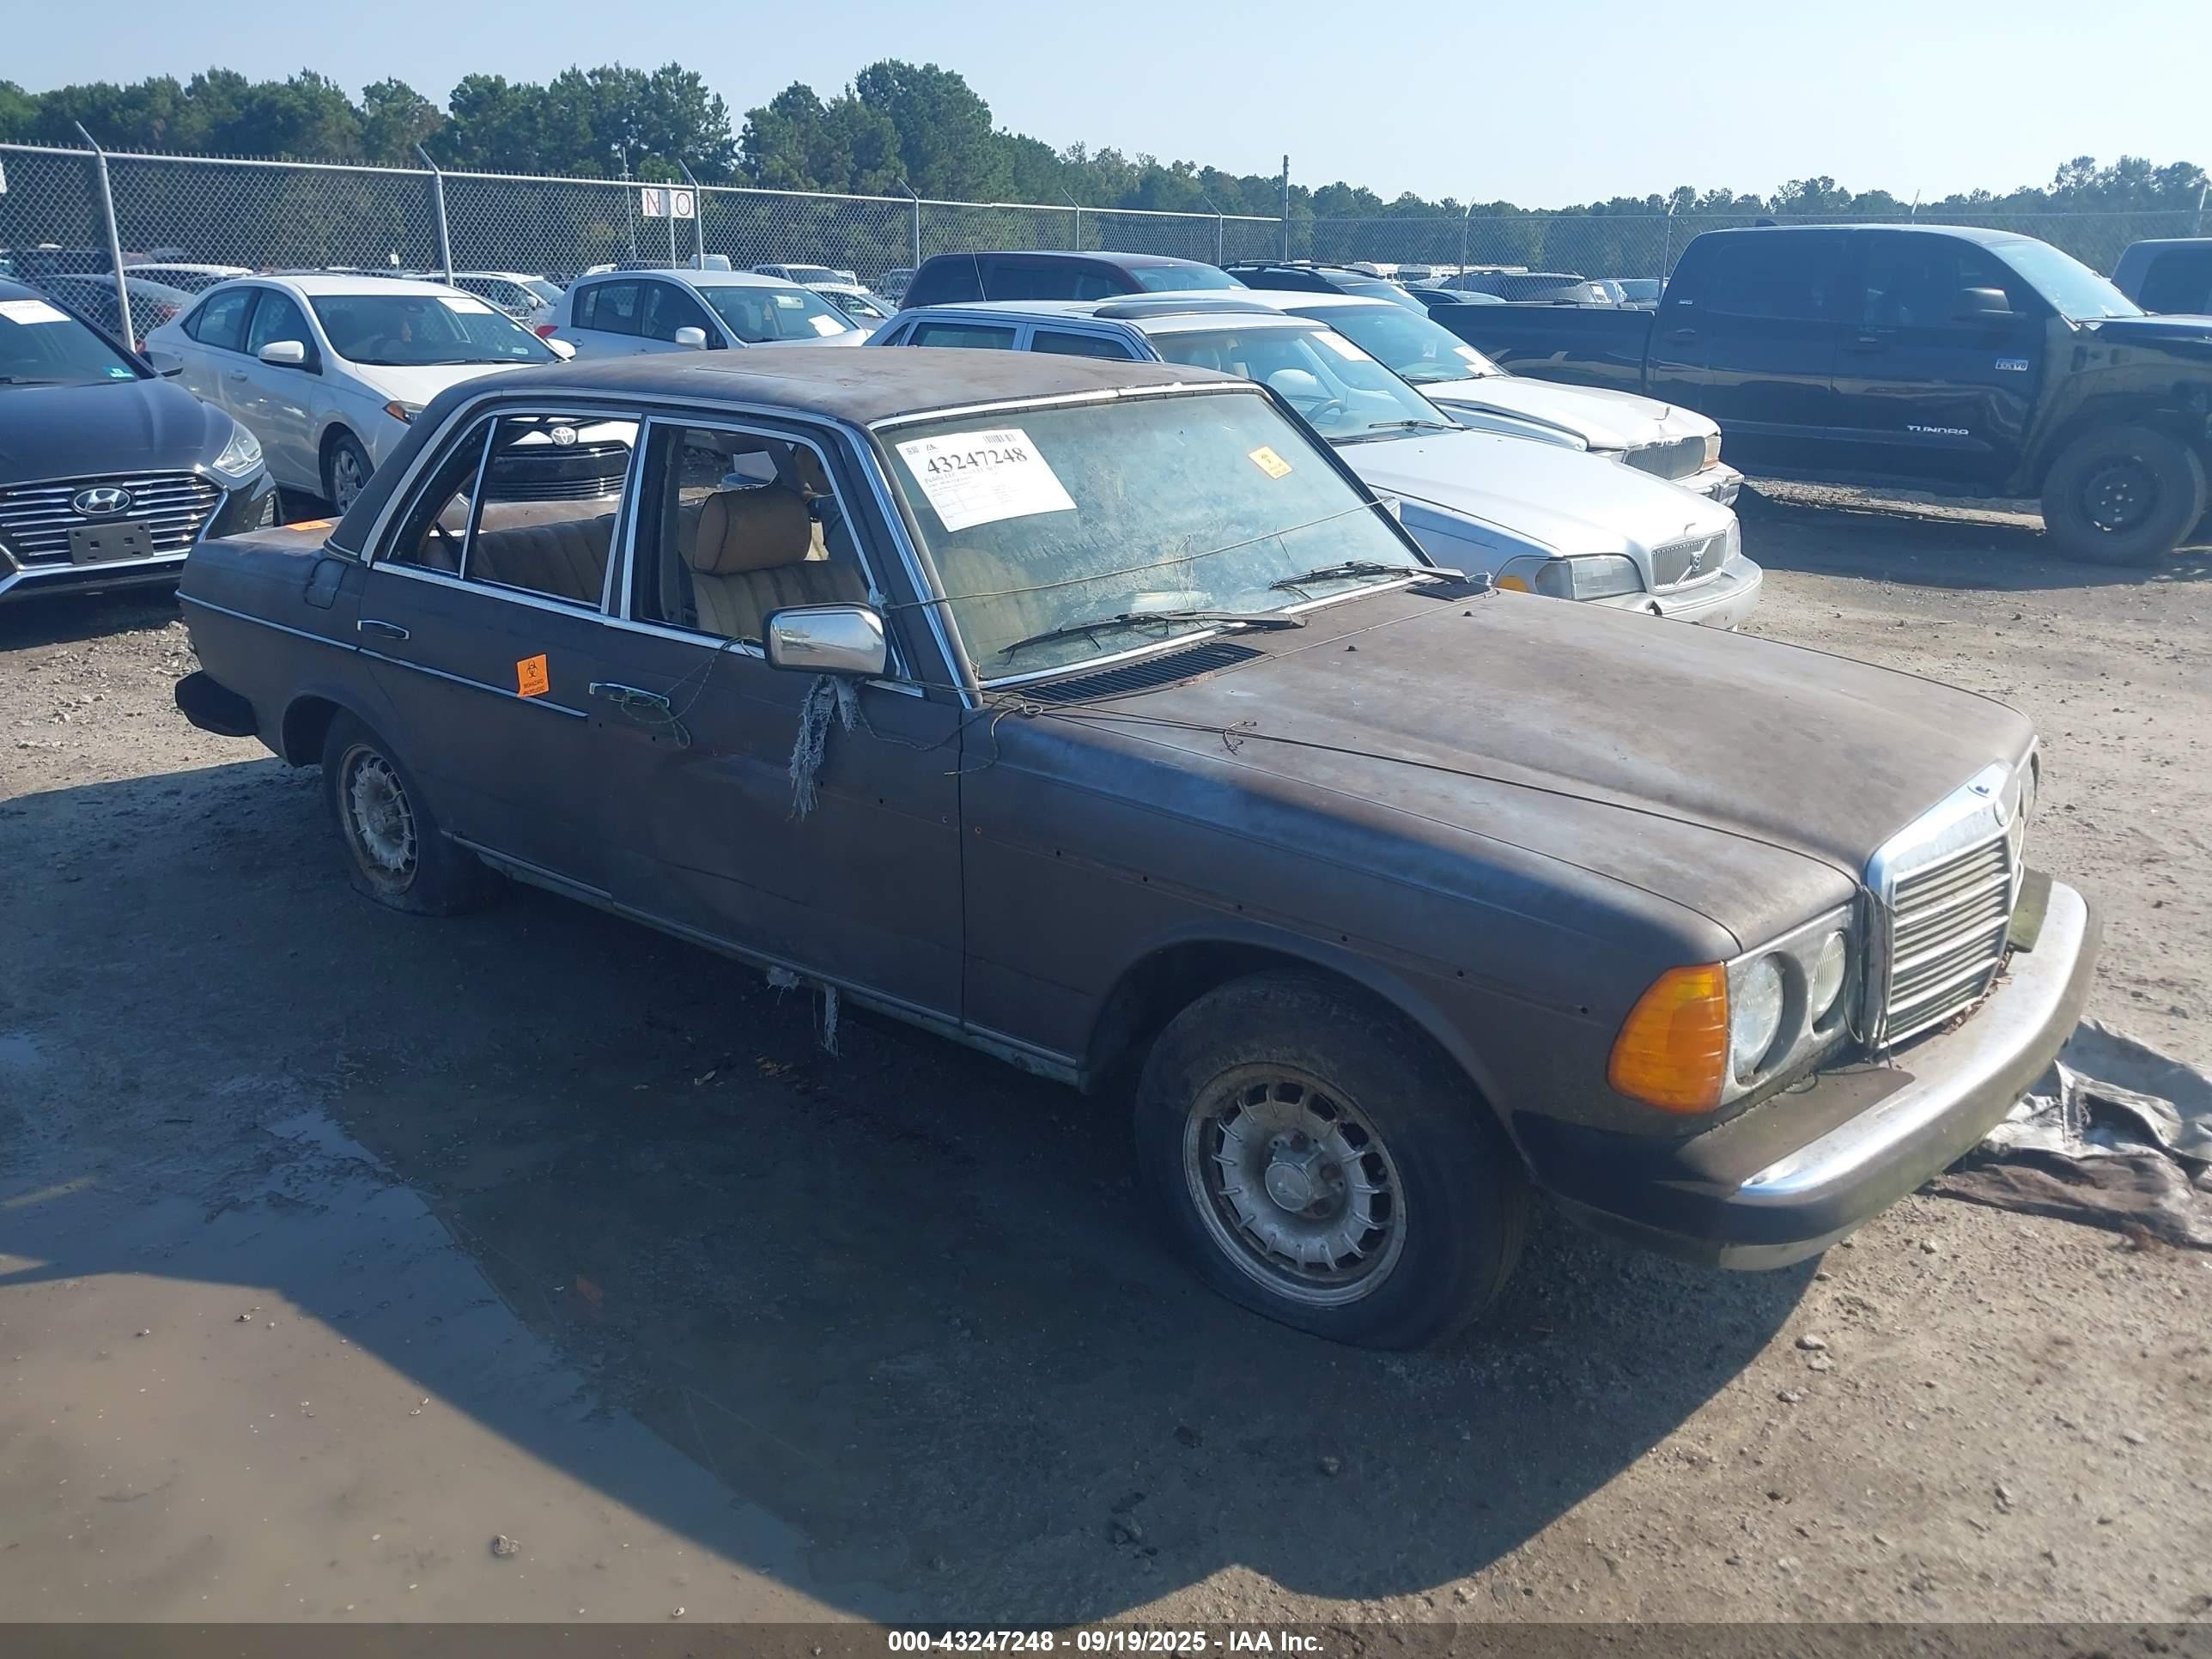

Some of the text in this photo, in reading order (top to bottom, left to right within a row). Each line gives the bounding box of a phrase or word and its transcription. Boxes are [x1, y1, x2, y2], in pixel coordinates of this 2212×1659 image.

[646, 190, 661, 215] N
[1906, 424, 1970, 435] TUNDRA
[927, 447, 1028, 474] 43247248
